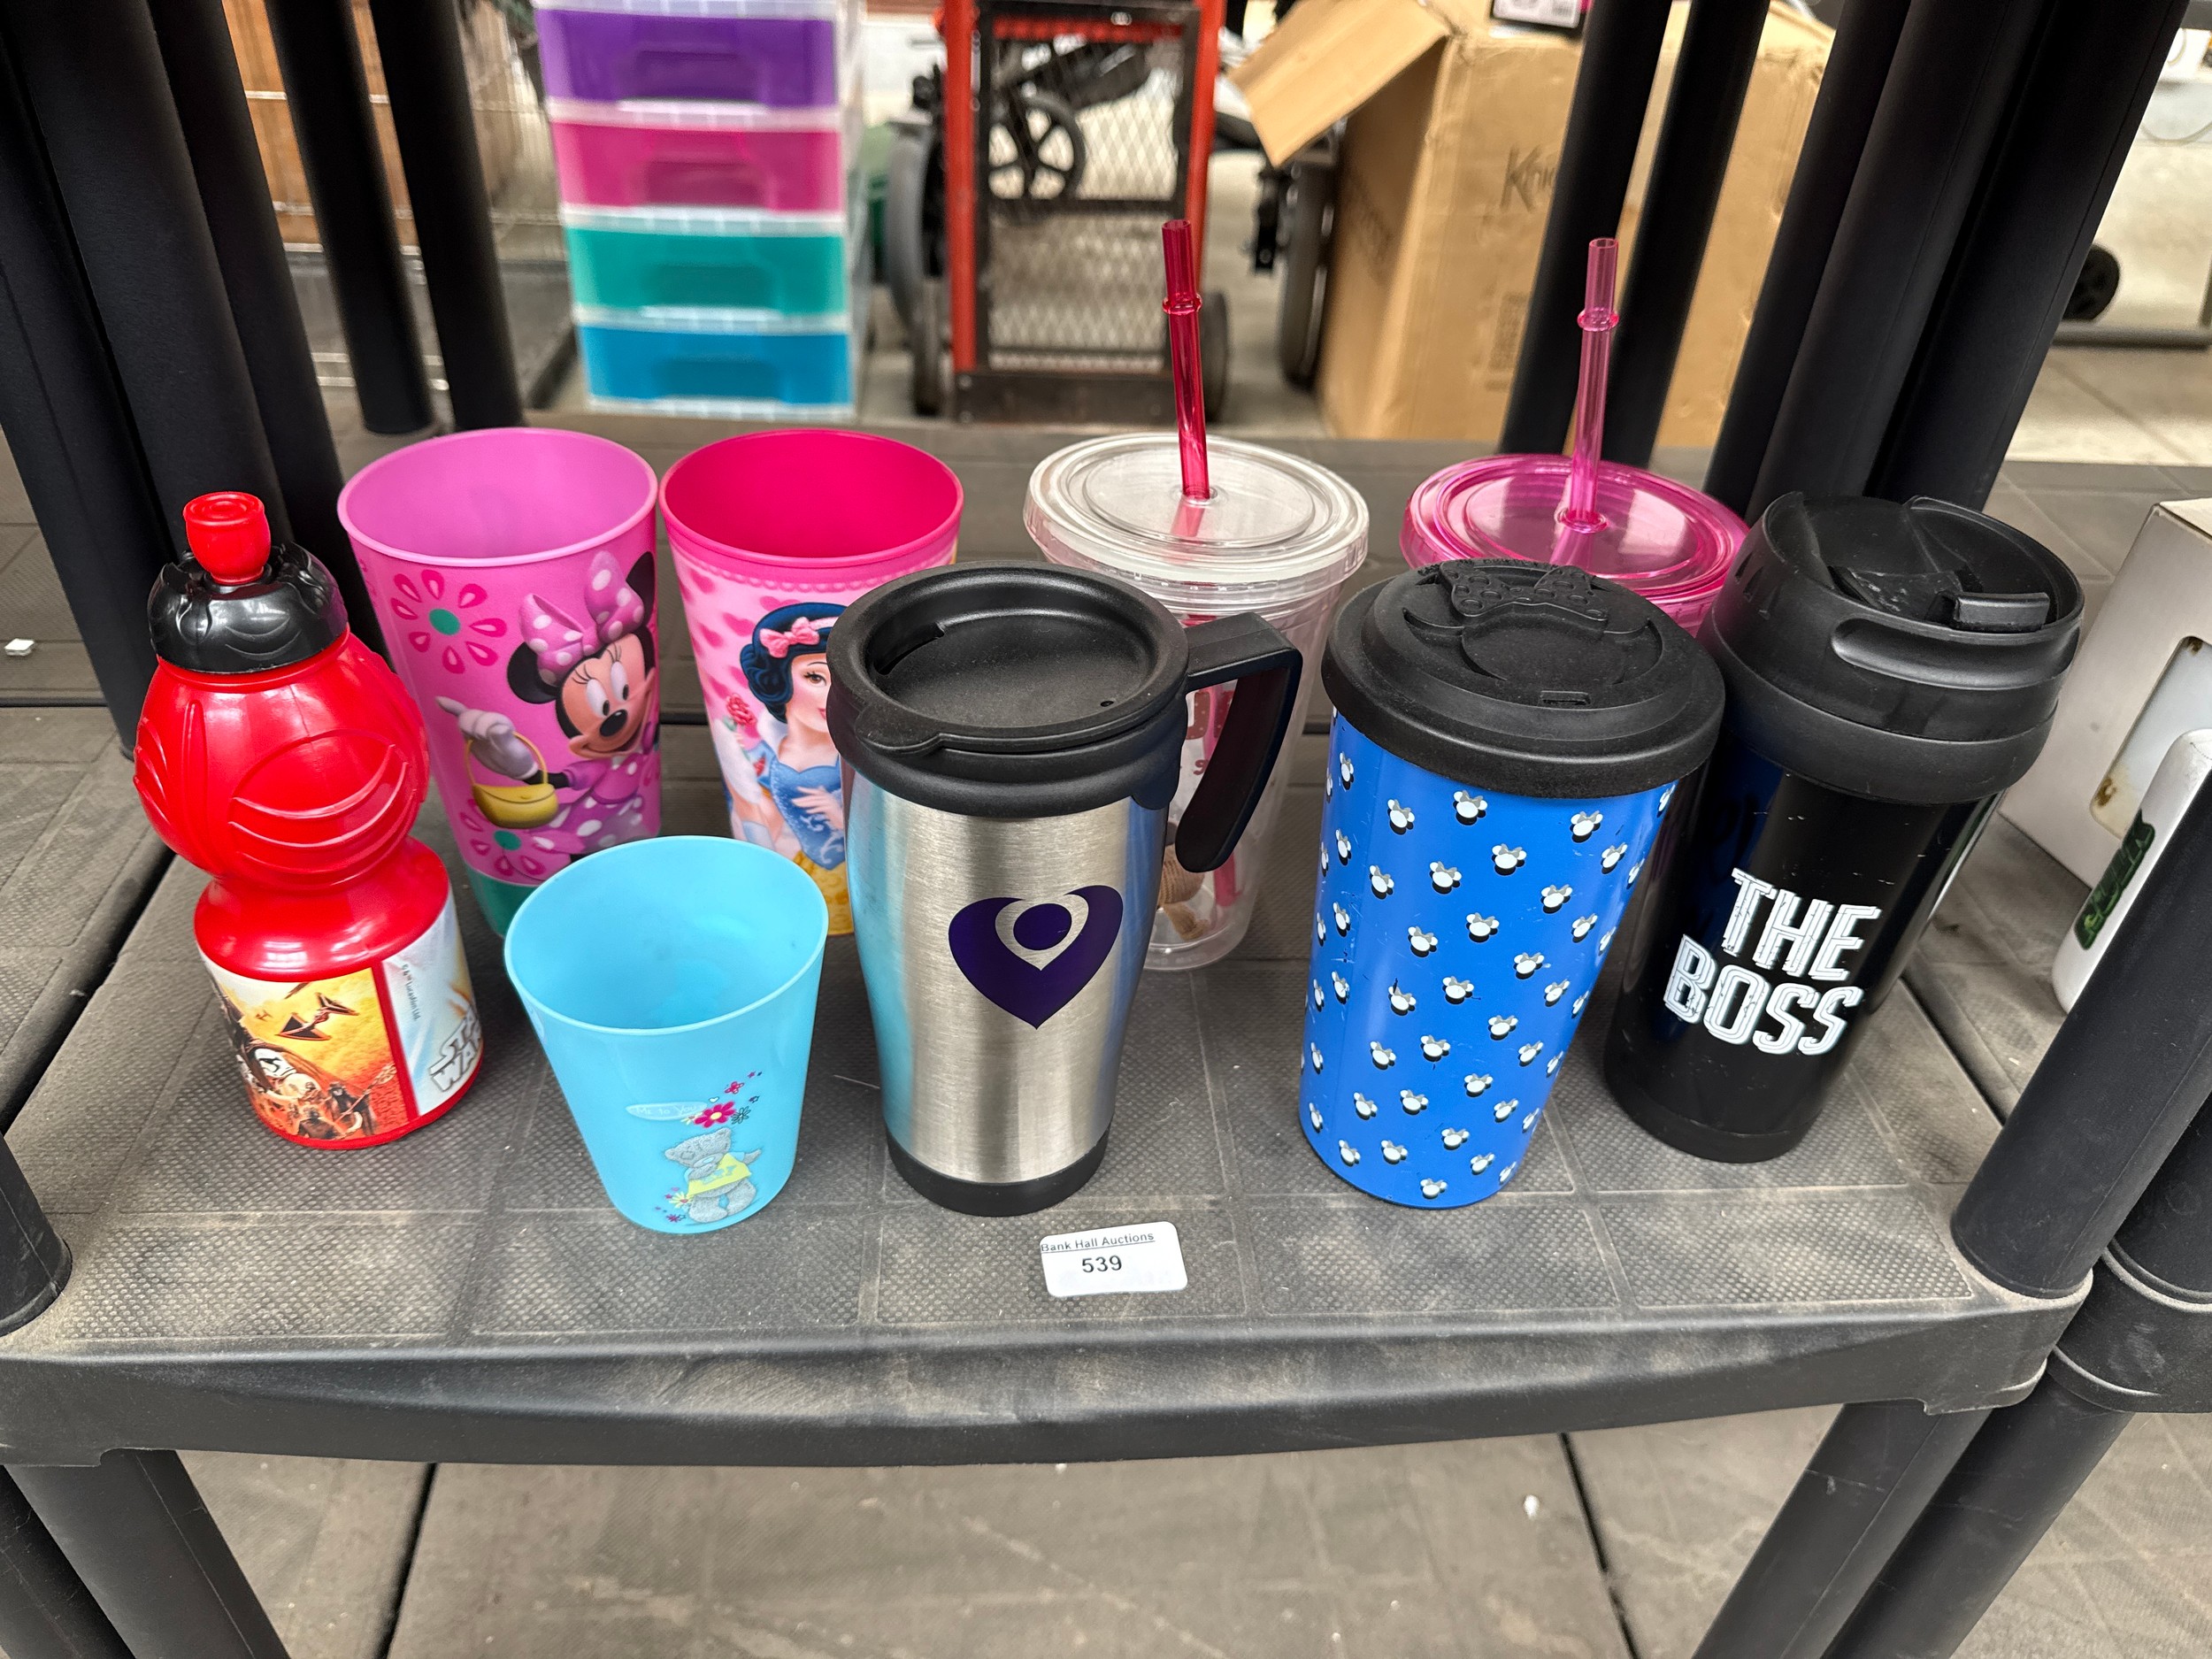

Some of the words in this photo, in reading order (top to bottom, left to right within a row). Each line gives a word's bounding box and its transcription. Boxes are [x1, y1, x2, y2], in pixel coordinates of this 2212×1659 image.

[1721, 867, 1882, 980] THE
[1663, 933, 1864, 1055] BOSS
[1041, 1241, 1071, 1252] Bank
[1075, 1238, 1098, 1248] Hall
[1102, 1232, 1155, 1246] Auctions
[1081, 1255, 1123, 1273] 539
